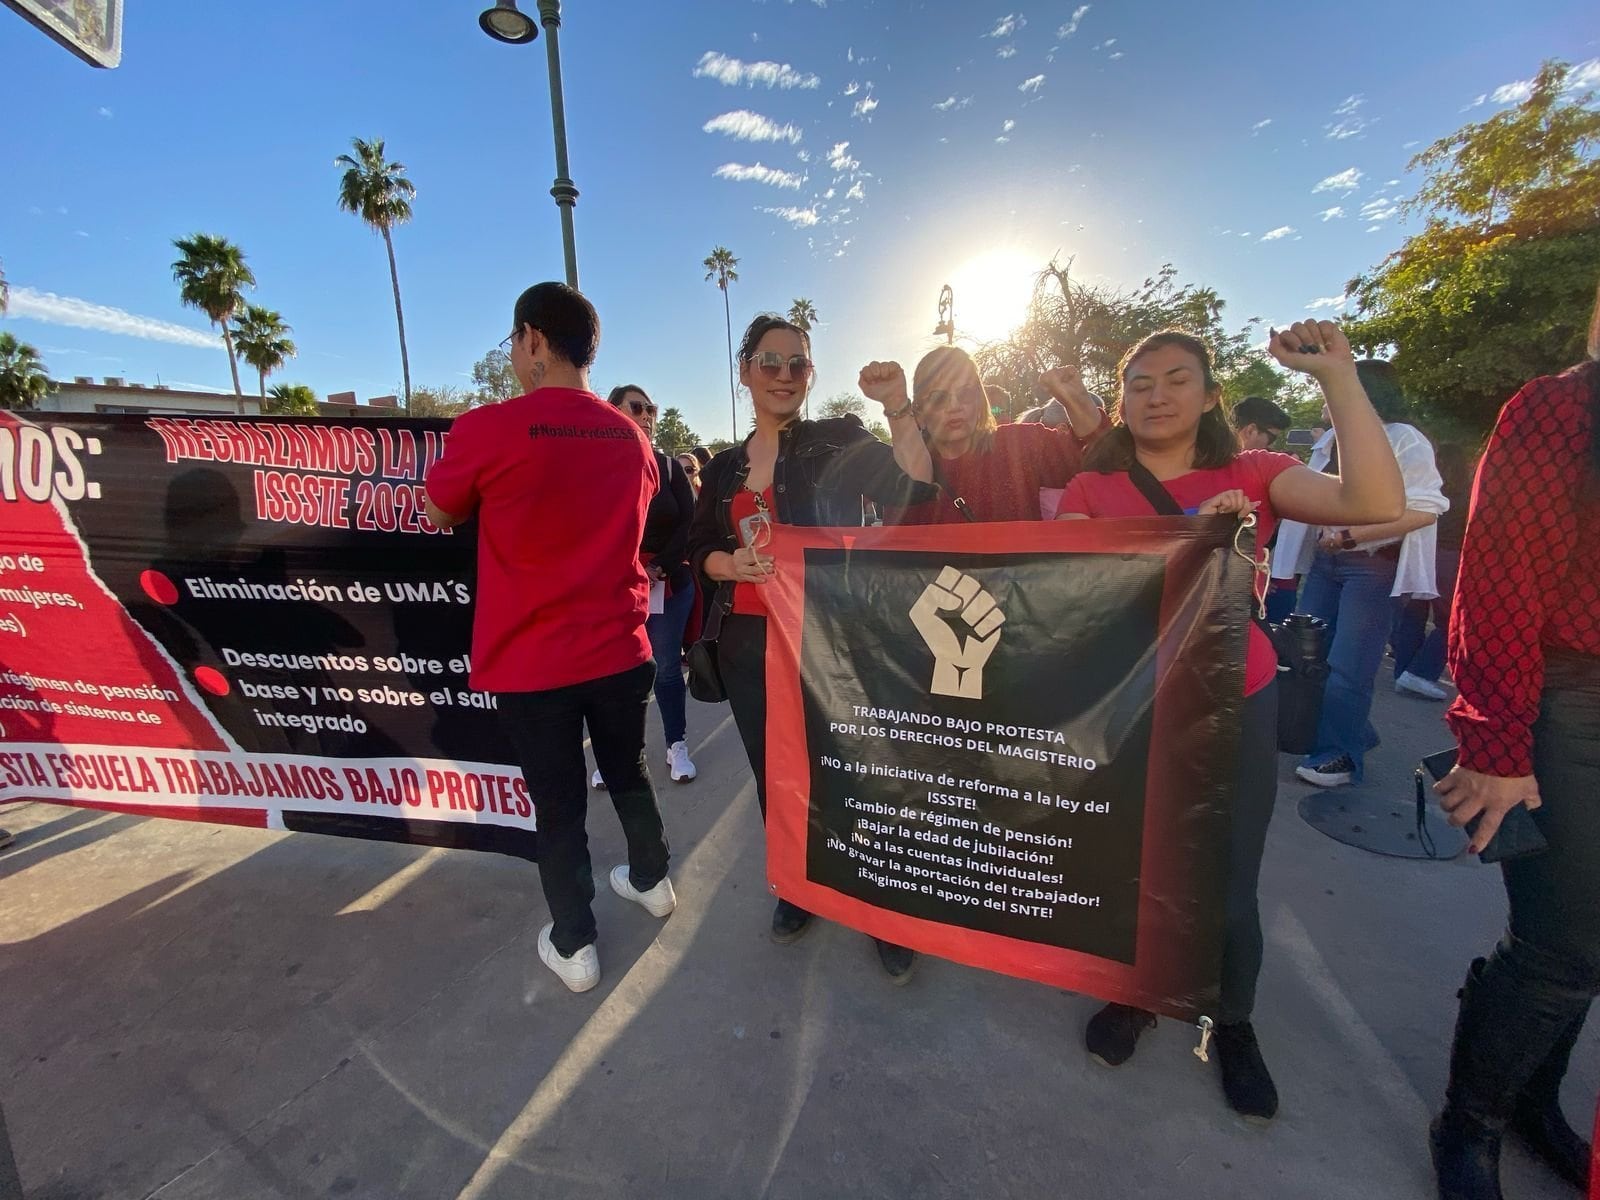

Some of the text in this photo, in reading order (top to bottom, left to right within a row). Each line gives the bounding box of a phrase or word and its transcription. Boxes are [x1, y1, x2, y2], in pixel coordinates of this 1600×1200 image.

[144, 417, 376, 477] ¡RECHAZAMOS
[377, 428, 417, 480] LA
[254, 470, 350, 529] ISSSTE
[18, 553, 45, 573] de
[0, 585, 84, 610] mujeres,
[185, 577, 344, 603] Eliminación
[347, 581, 381, 603] de
[222, 648, 472, 675] Descuentos sobre el
[2, 669, 180, 702] régimen de pensión
[239, 679, 299, 700] base
[301, 685, 317, 705] y
[322, 686, 354, 702] no
[359, 685, 425, 706] sobre
[430, 687, 453, 706] el
[0, 694, 162, 725] ción de sistema de
[253, 709, 367, 734] integrado
[853, 705, 1065, 745] TRABAJANDO BAJO PROTESTA
[830, 722, 1096, 771] POR LOS DERECHOS DEL MAGISTERIO
[50, 753, 159, 793] ESCUELA
[156, 757, 344, 801] TRABAJAMOS
[342, 767, 421, 807] BAJO
[821, 755, 1110, 814] ¡NO a la iniciativa de reforma a la ley del
[927, 791, 976, 811] ISSSTE!
[844, 797, 1073, 849] ¡Cambio de régimen de pensión!
[857, 818, 1054, 865] ¡Bajar la edad de jubilación!
[827, 838, 1101, 907] ¡No gravar la aportación del trabajador!
[851, 832, 1063, 884] ¡No a las cuentas individuales!
[858, 867, 1053, 919] ¡Exigimos el apoyo del SNTE!
